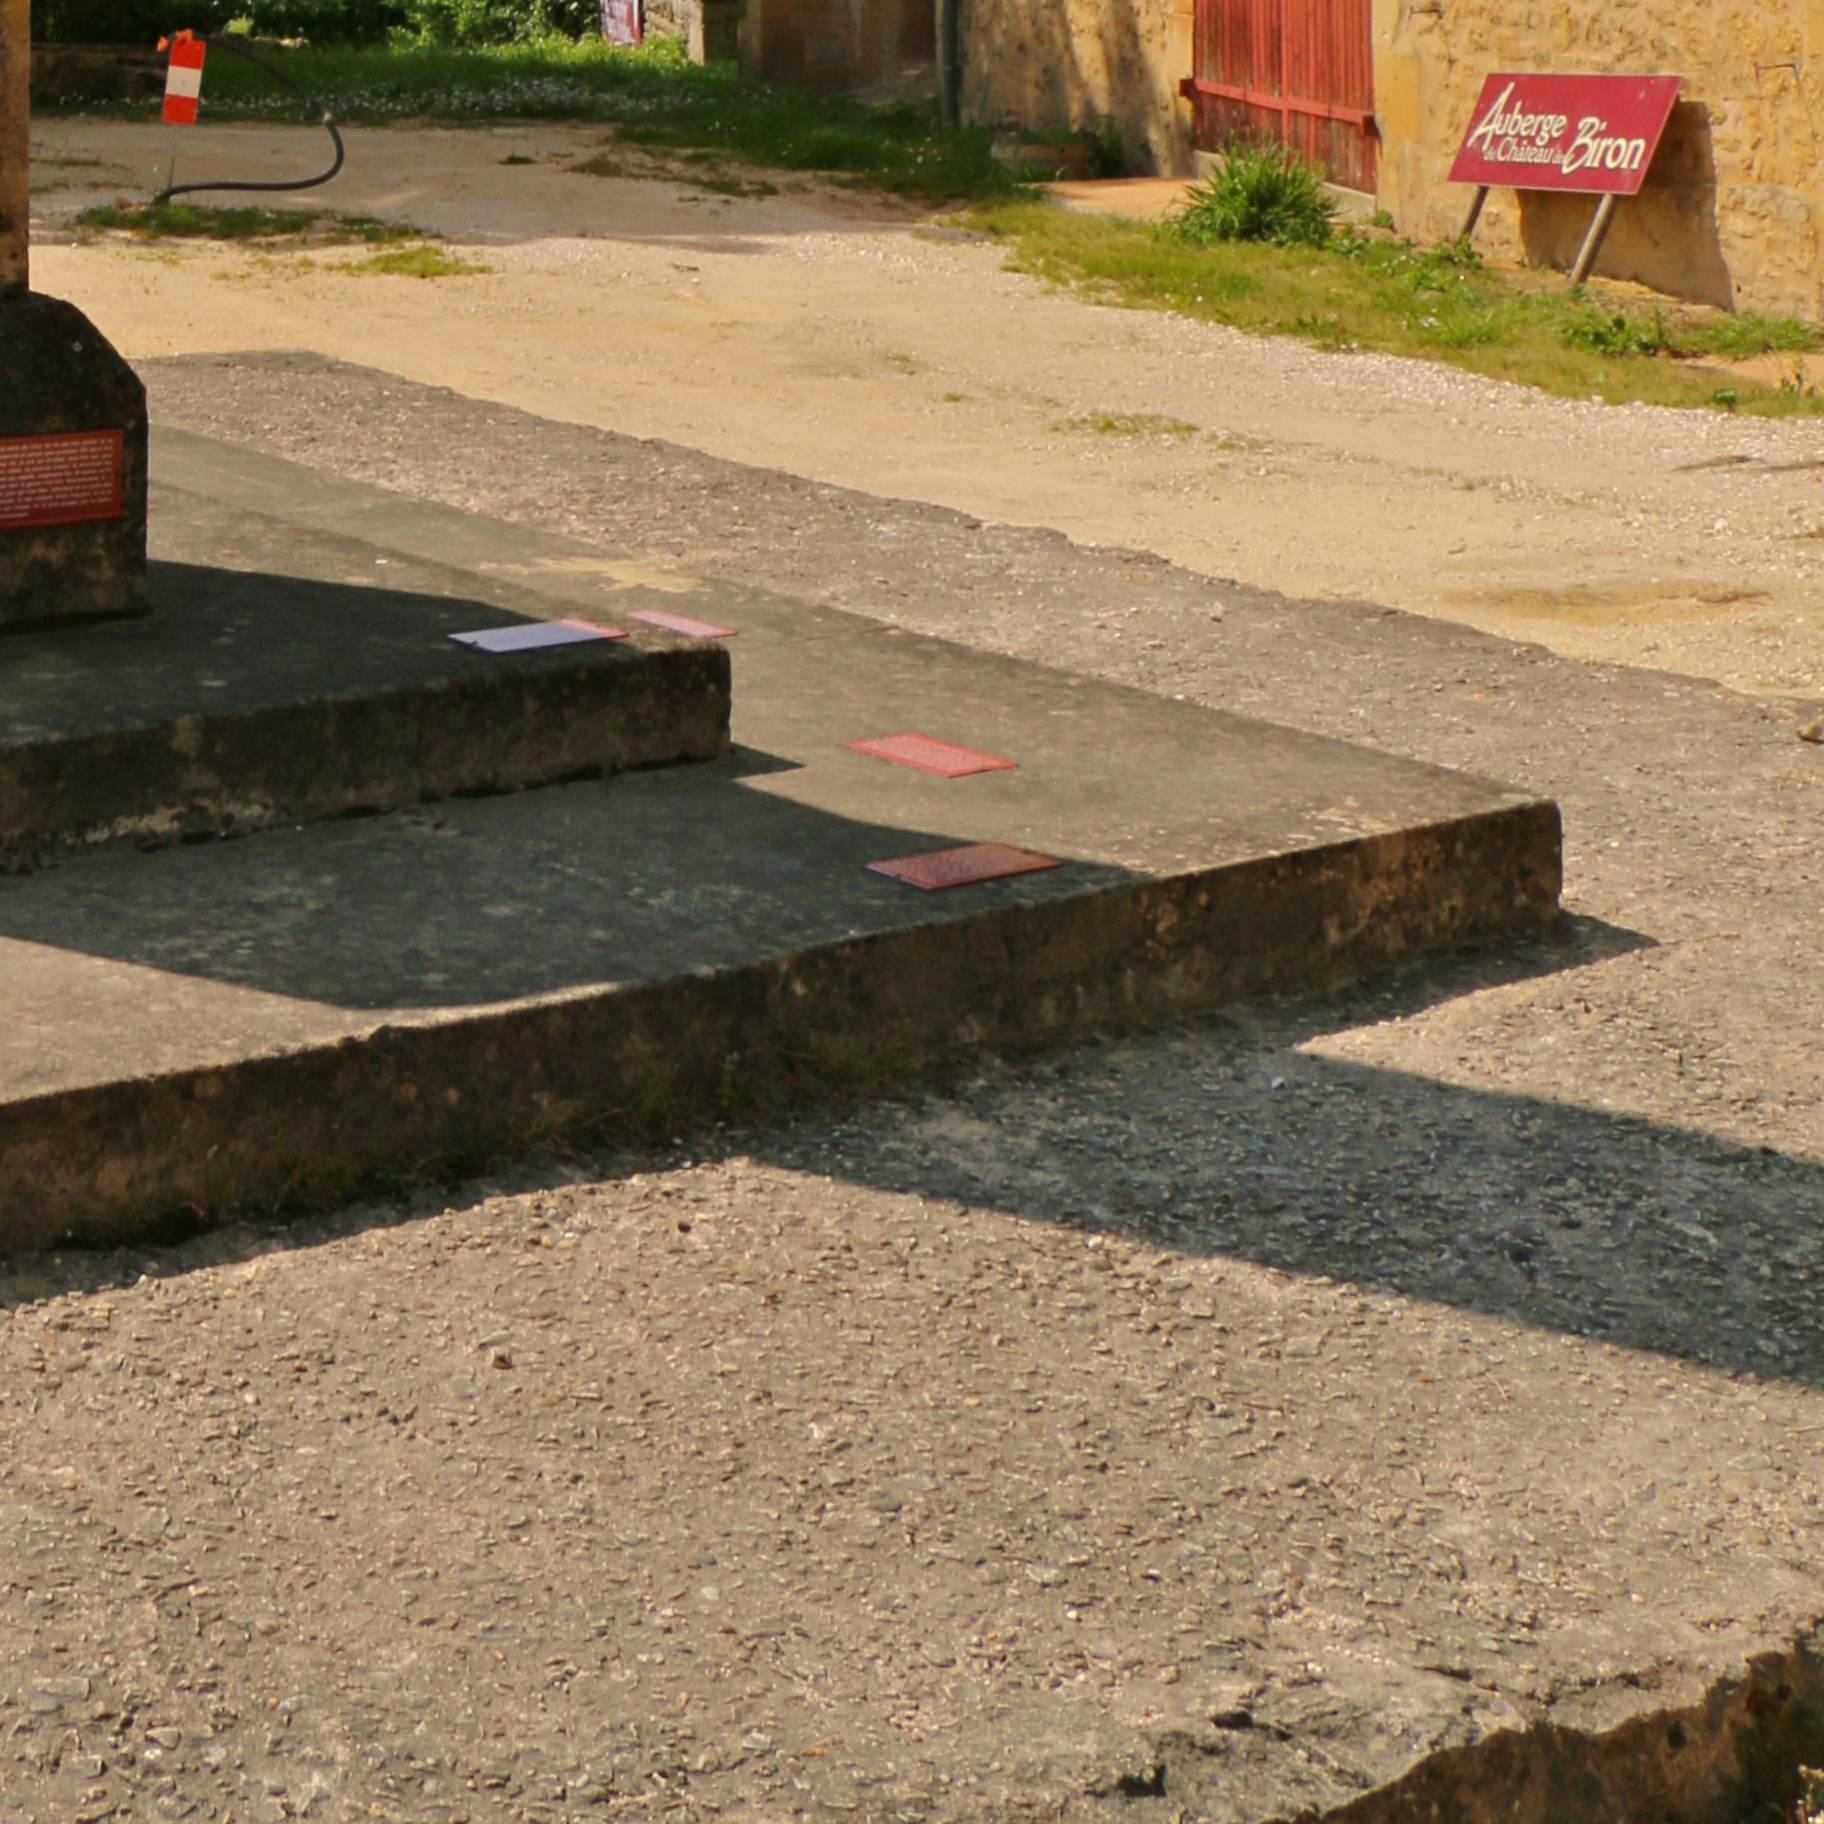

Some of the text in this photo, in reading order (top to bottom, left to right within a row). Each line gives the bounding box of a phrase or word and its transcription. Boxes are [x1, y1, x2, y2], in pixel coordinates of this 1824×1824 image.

[1466, 81, 1568, 152] Auberge
[1496, 136, 1553, 164] Château
[1560, 116, 1646, 175] Biron
